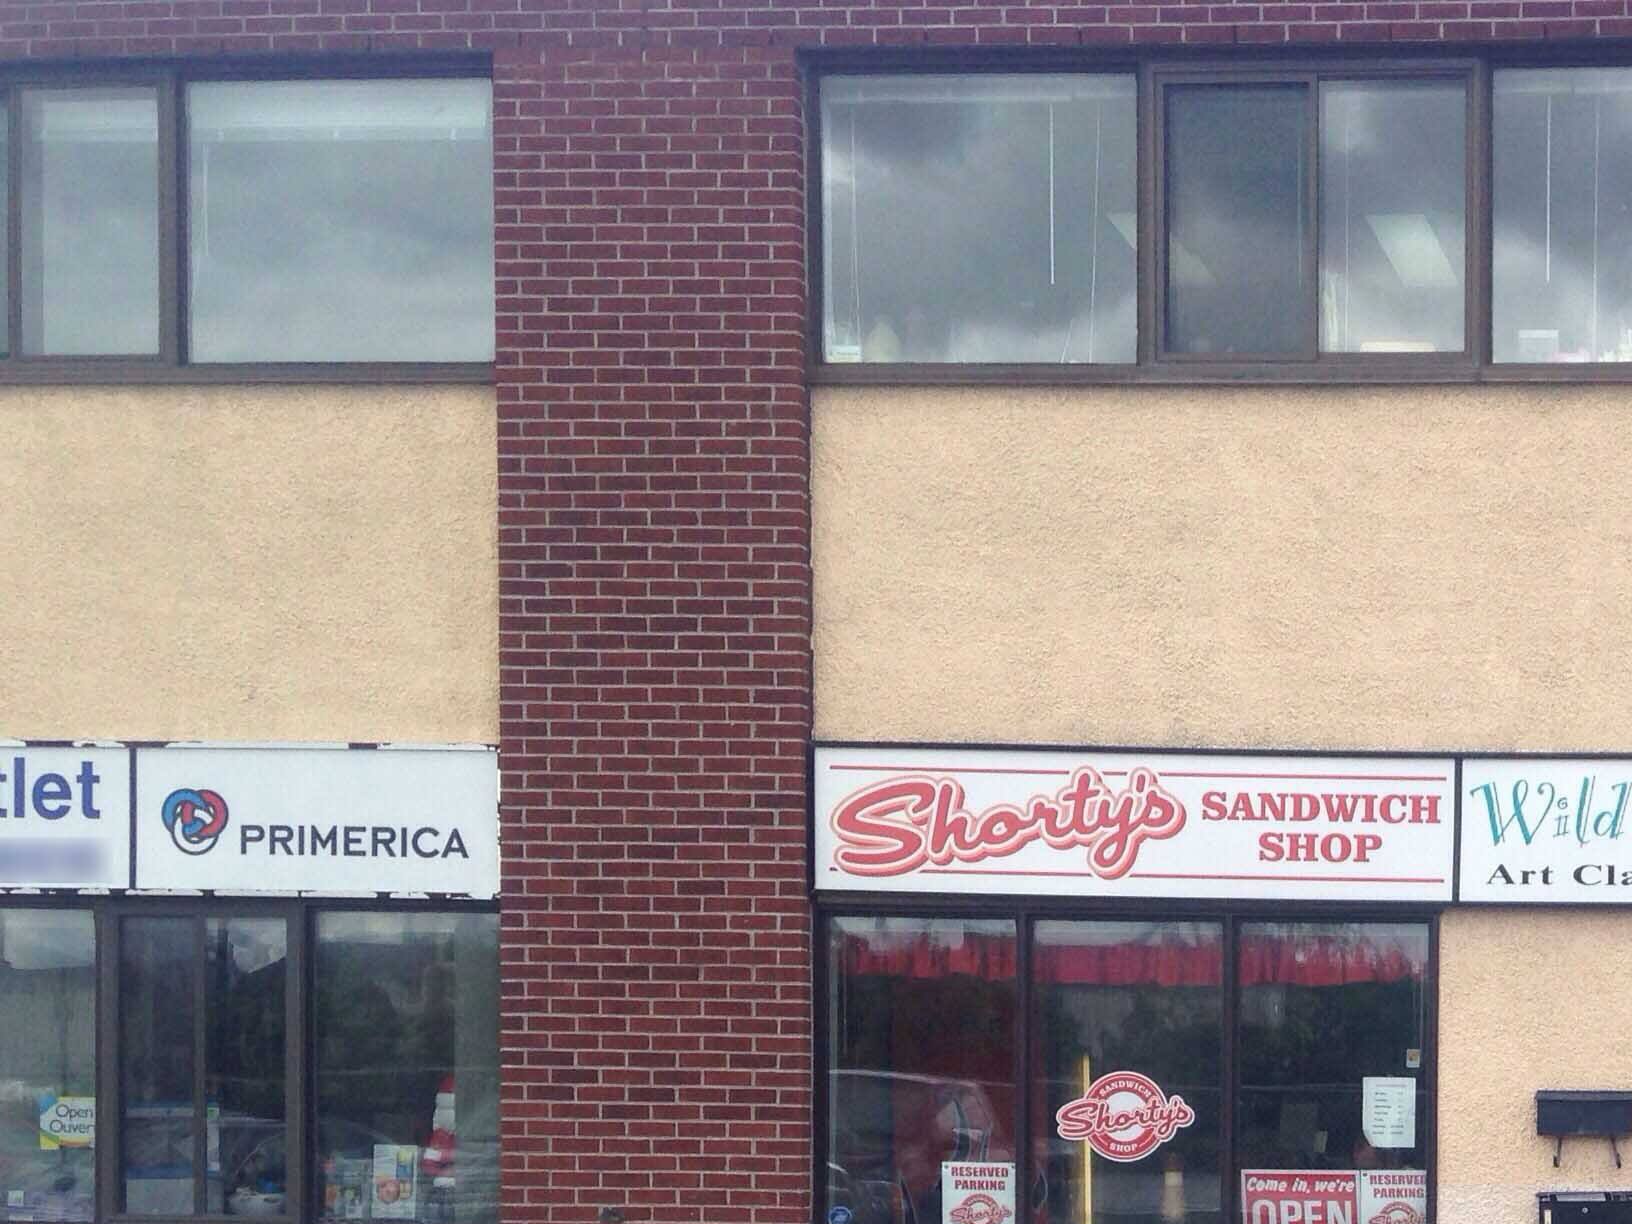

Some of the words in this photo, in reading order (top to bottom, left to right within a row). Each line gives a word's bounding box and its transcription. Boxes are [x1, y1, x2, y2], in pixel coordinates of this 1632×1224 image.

[1201, 791, 1442, 824] SANDWICH
[1469, 775, 1632, 848] Wild
[834, 768, 1186, 878] Shorty's
[240, 824, 469, 858] PRIMERICA
[1258, 832, 1383, 863] SHOP
[1486, 863, 1554, 886] Art
[1099, 1079, 1152, 1098] SANDWICH
[56, 1104, 95, 1122] Open
[1059, 1098, 1192, 1138] Shorty's
[50, 1119, 96, 1134] Ouver
[1109, 1142, 1138, 1153] SHOP
[951, 1166, 1009, 1178] RESERVED
[954, 1179, 1006, 1191] PARKING
[1246, 1176, 1287, 1192] Come
[1314, 1178, 1355, 1193] we're
[1374, 1187, 1425, 1198] PARKING
